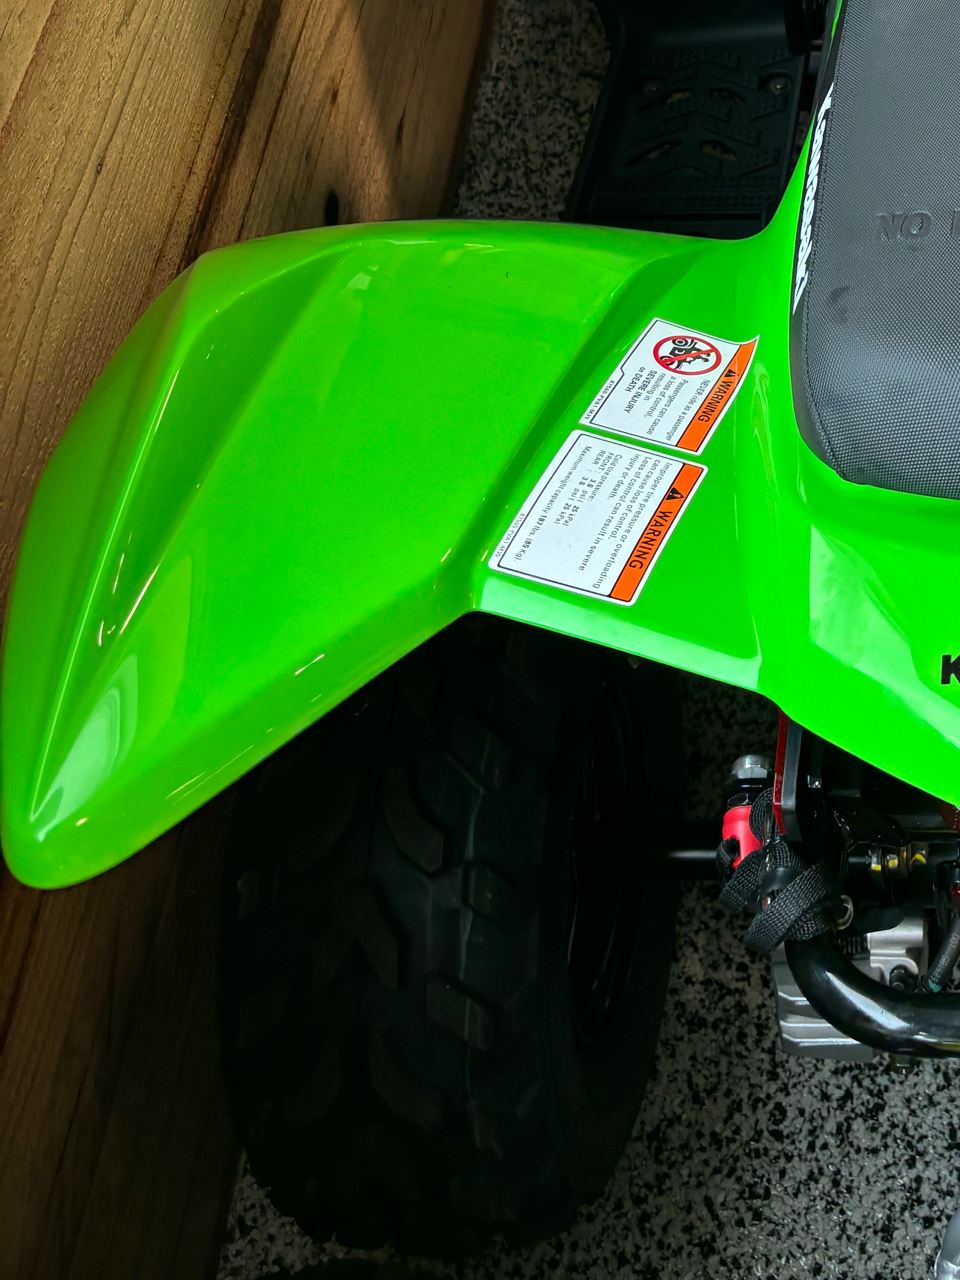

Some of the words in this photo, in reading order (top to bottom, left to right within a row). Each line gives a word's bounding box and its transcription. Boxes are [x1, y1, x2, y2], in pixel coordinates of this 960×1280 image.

[873, 211, 932, 241] NO
[624, 373, 642, 392] DEATH
[637, 369, 657, 391] SEVERE
[646, 372, 666, 394] resulting
[662, 379, 675, 390] loss
[694, 379, 710, 395] NEVER
[623, 391, 642, 413] INJURY
[664, 378, 688, 407] Passengers
[688, 394, 697, 404] ride
[697, 378, 733, 424] WARNING
[657, 407, 667, 418] can
[646, 418, 660, 434] cause
[598, 452, 613, 471] FRONT
[609, 454, 622, 466] Cold
[624, 453, 640, 471] injury
[637, 456, 651, 470] Loss
[650, 459, 660, 470] can
[603, 466, 613, 475] tire
[638, 470, 653, 489] cause
[650, 462, 672, 490] Improper
[618, 478, 636, 502] control
[629, 489, 643, 503] loss
[642, 491, 653, 502] tire
[610, 502, 621, 514] can
[624, 502, 645, 533] pressure
[625, 504, 632, 512] of
[597, 515, 613, 536] result
[619, 534, 627, 542] or
[628, 510, 672, 569] WARNING
[578, 545, 596, 570] severe
[592, 543, 622, 588] overloading
